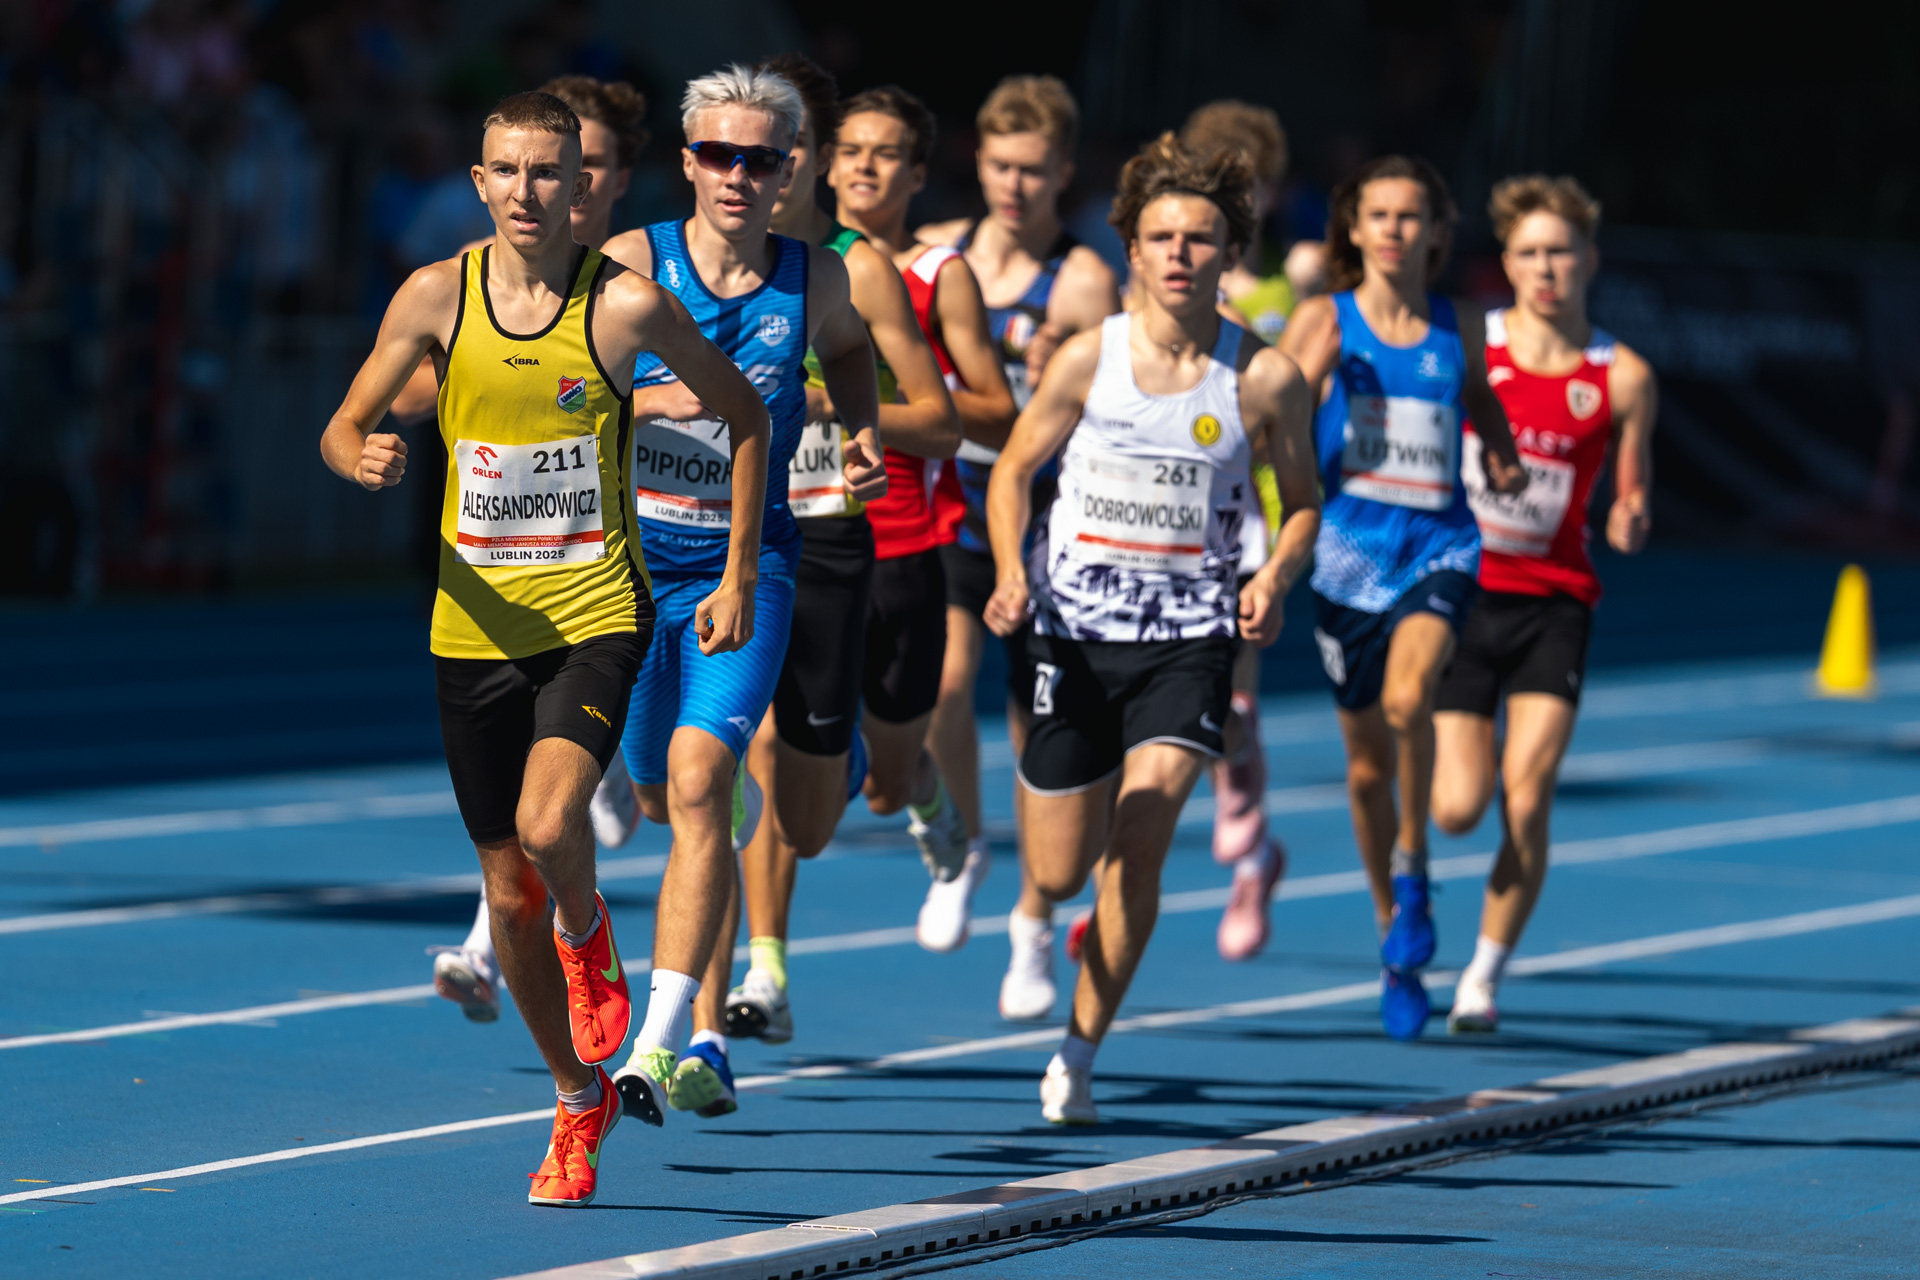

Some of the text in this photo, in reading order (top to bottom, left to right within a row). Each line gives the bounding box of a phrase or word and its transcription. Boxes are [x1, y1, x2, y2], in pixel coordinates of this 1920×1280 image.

[532, 444, 586, 474] 211
[472, 466, 502, 479] ORLEN
[1153, 463, 1198, 487] 261
[462, 488, 597, 521] ALEKSANDROWICZ
[654, 505, 725, 523] LUBLIN 2025
[1084, 495, 1203, 532] DOBROWOLSKI
[540, 538, 583, 547] KUSOCIŃSKIEGO
[490, 549, 566, 560] LUBLIN 2025
